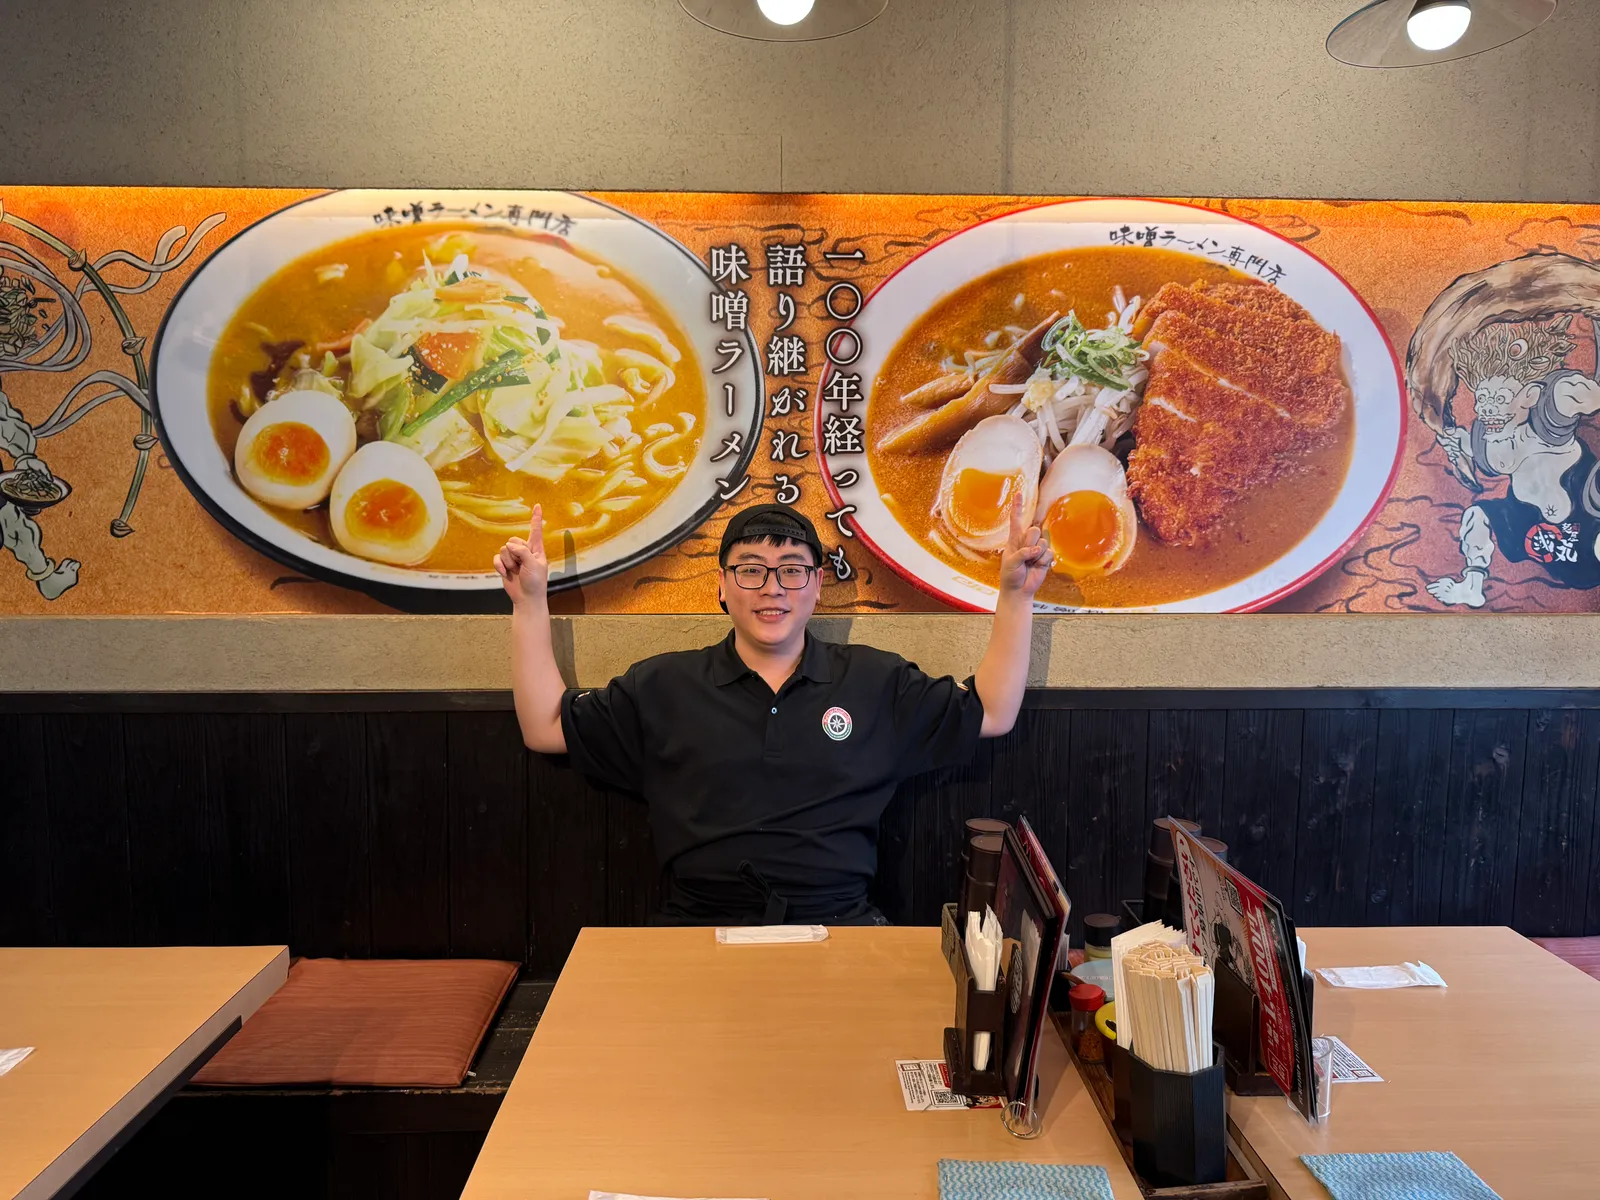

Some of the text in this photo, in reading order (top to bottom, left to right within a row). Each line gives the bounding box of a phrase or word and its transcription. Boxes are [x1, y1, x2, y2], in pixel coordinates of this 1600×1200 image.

[373, 201, 577, 236] 味噌ラーメン専門店
[1109, 224, 1287, 285] 味噌ラーメン専門店
[710, 245, 749, 501] 味噌ラーメン
[767, 244, 807, 505] 語り継がれる
